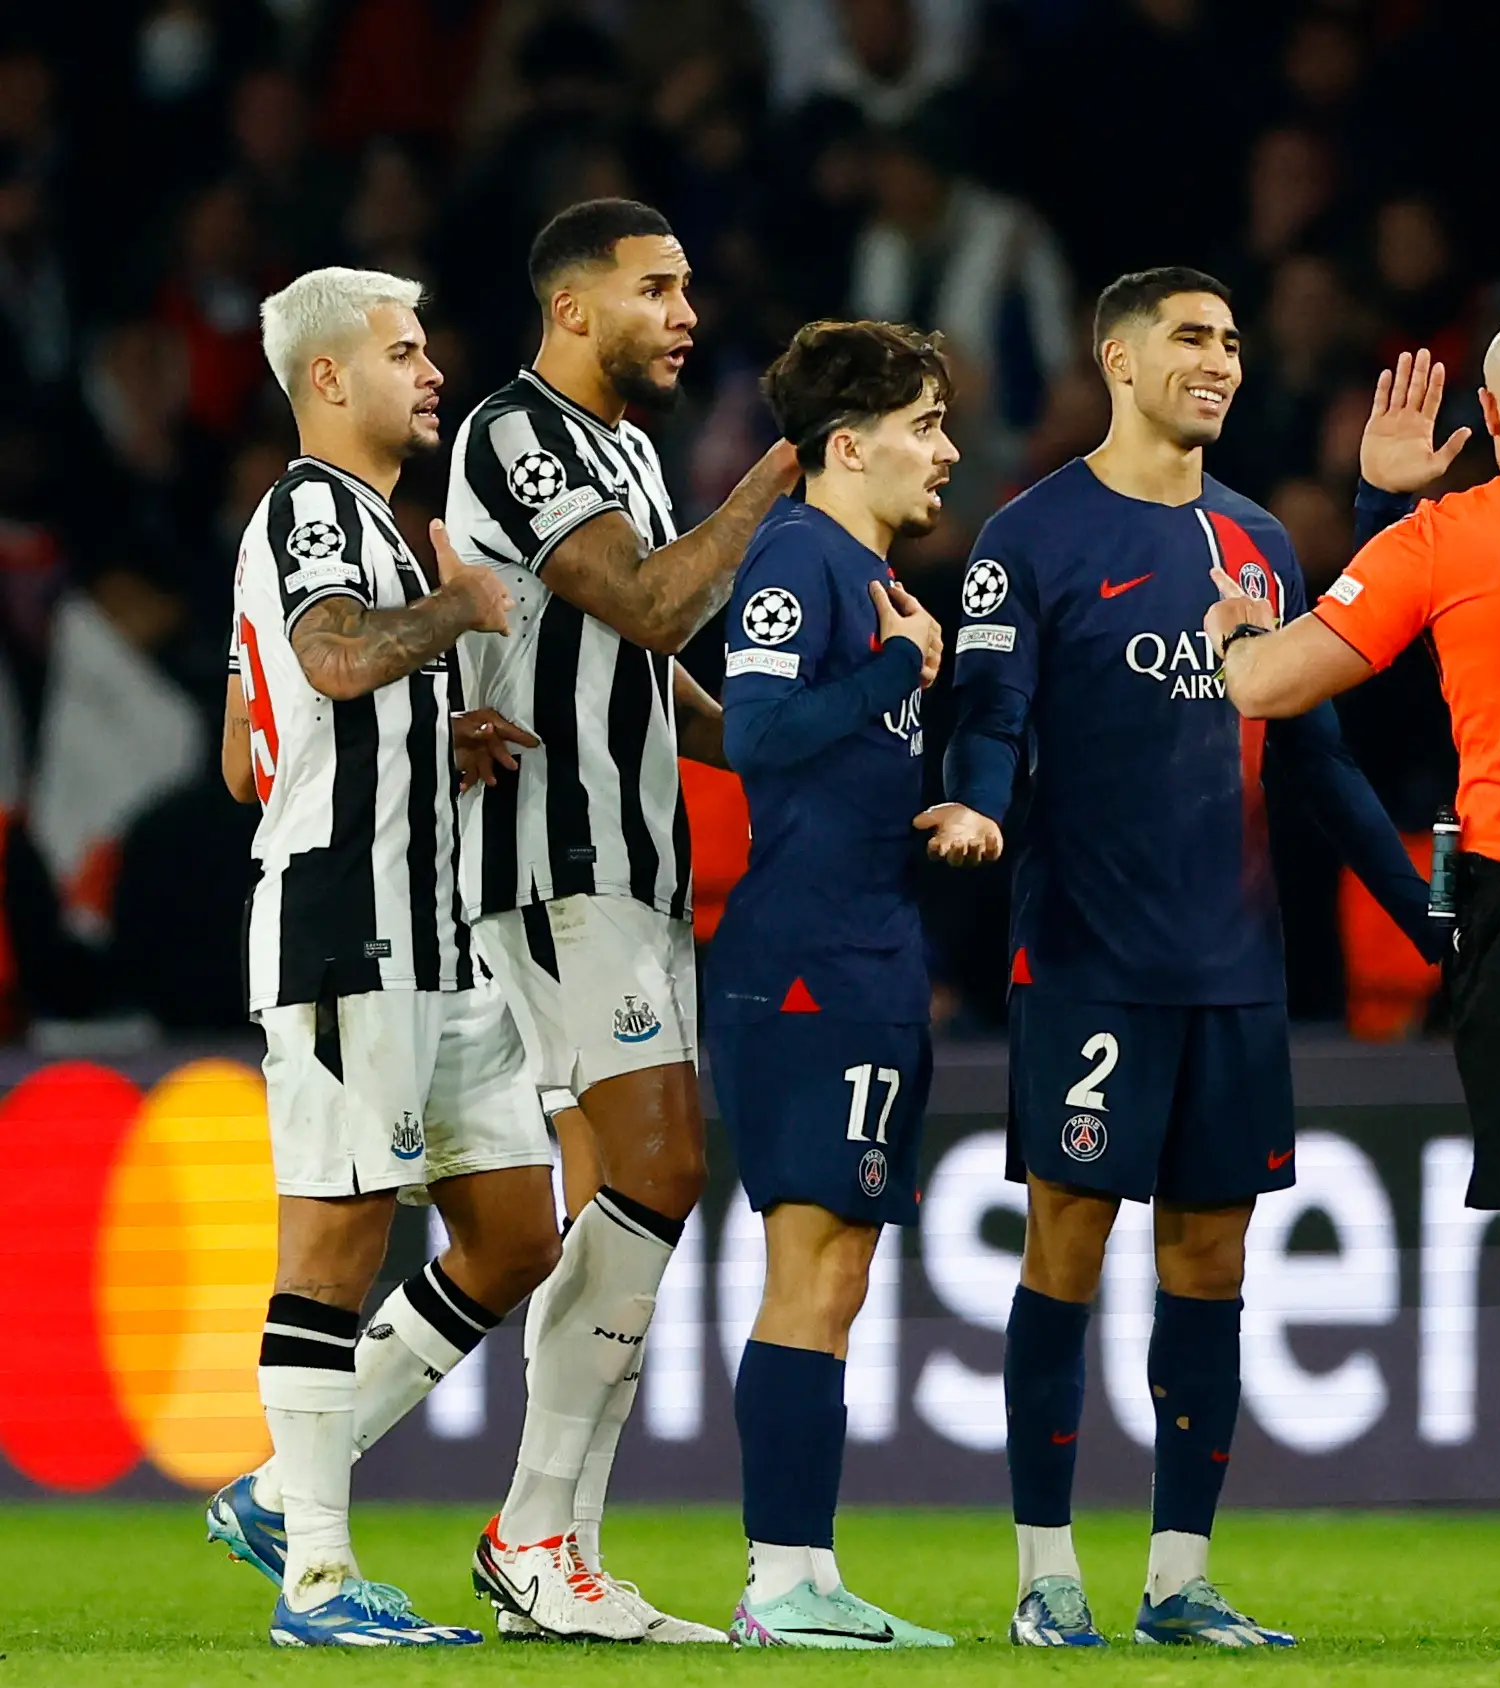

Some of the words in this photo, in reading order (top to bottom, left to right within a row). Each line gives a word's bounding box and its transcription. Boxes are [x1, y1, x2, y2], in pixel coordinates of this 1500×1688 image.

[1125, 630, 1216, 682] QAT
[843, 1062, 900, 1145] 17
[1064, 1032, 1119, 1112] 2
[1070, 1116, 1101, 1131] PARIS
